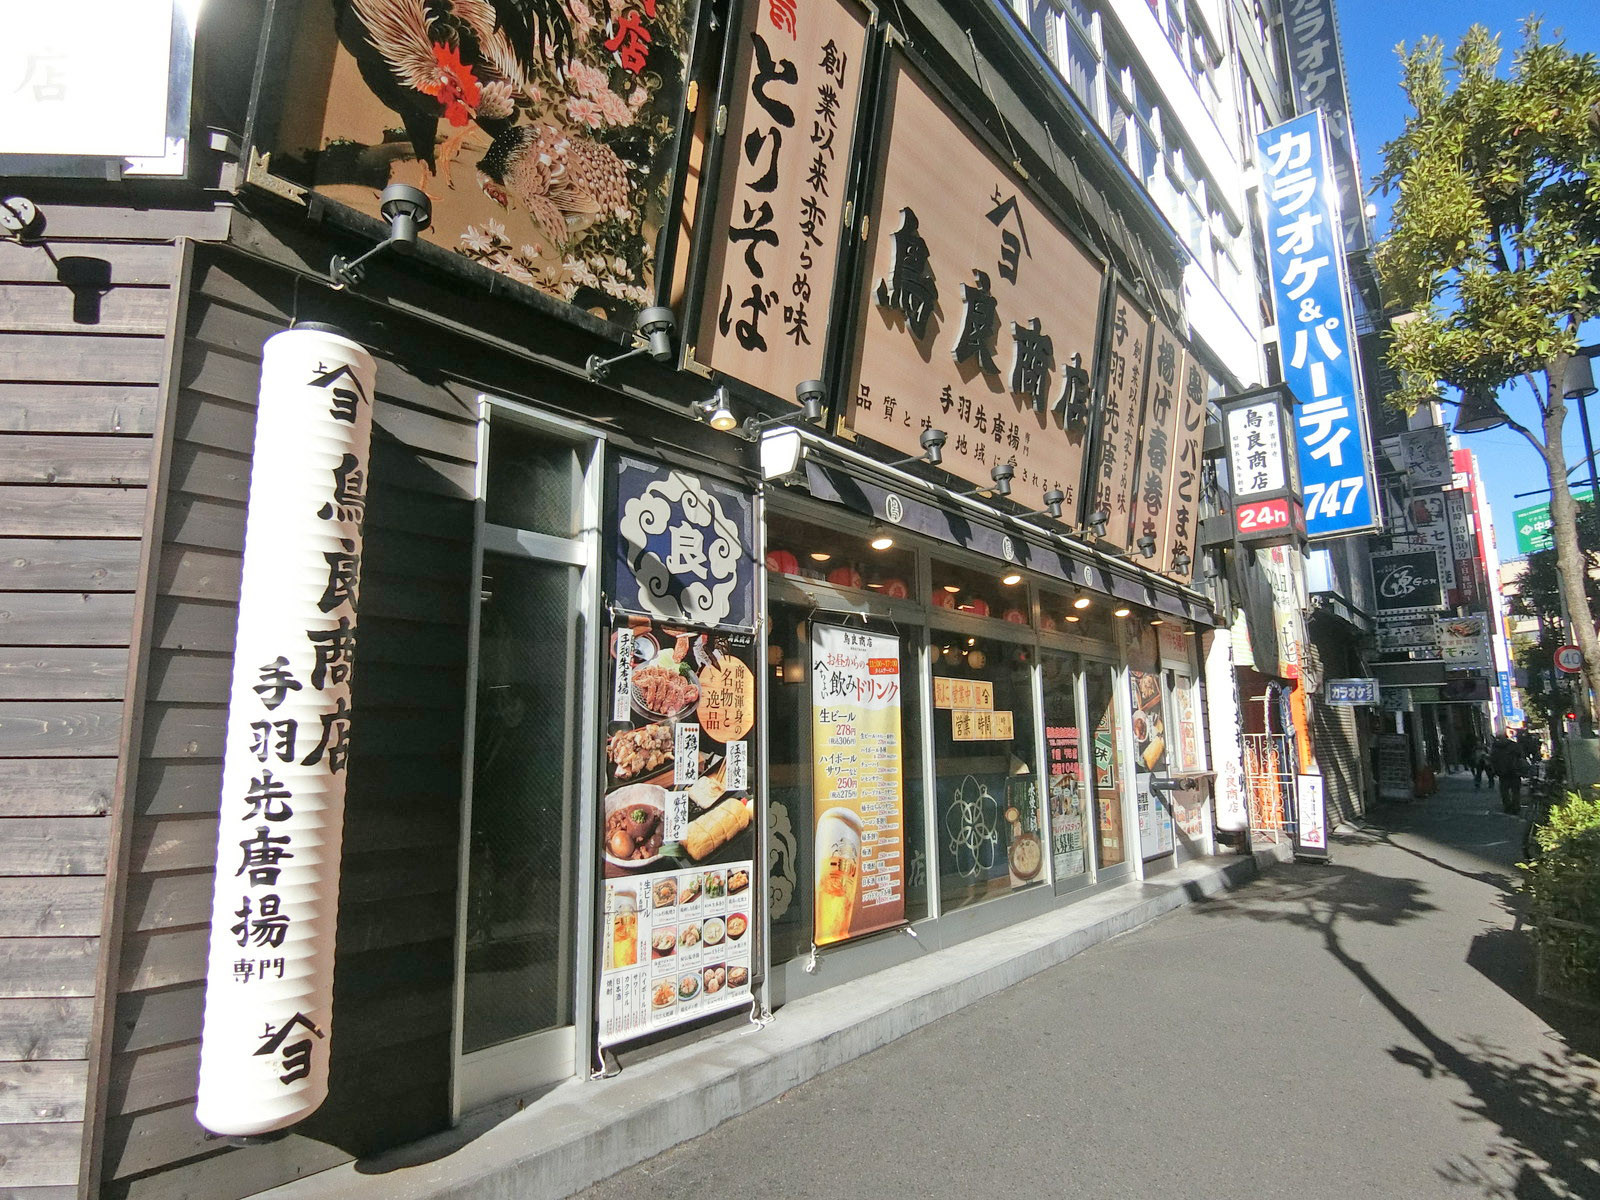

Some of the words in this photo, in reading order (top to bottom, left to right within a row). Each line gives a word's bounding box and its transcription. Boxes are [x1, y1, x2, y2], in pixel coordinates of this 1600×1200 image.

[719, 32, 798, 353] とりそば
[783, 39, 848, 346] 創業以来変らぬ味
[872, 206, 1091, 432] 鳥良商店
[1267, 130, 1351, 468] カラオケ&パーティ
[939, 384, 1020, 455] 手羽先唐揚
[1096, 305, 1128, 528] 手羽先唐揚
[1243, 409, 1269, 491] 鳥良商店
[1303, 476, 1364, 522] 747
[665, 520, 709, 581] 良
[300, 452, 367, 775] 鳥良商店
[826, 652, 866, 670] お昼からの
[1562, 652, 1581, 666] 40
[706, 689, 720, 730] 逸品
[720, 667, 734, 729] 名物と
[734, 664, 746, 735] 商店渾身の
[819, 707, 856, 723] 生ビール
[1331, 685, 1366, 699] カラオケ
[819, 752, 858, 765] ハイボール
[836, 724, 857, 737] 278円
[230, 655, 303, 949] 手羽先唐揚
[837, 777, 858, 790] 250円
[643, 879, 652, 919] 生ビール
[232, 956, 285, 984] 専門
